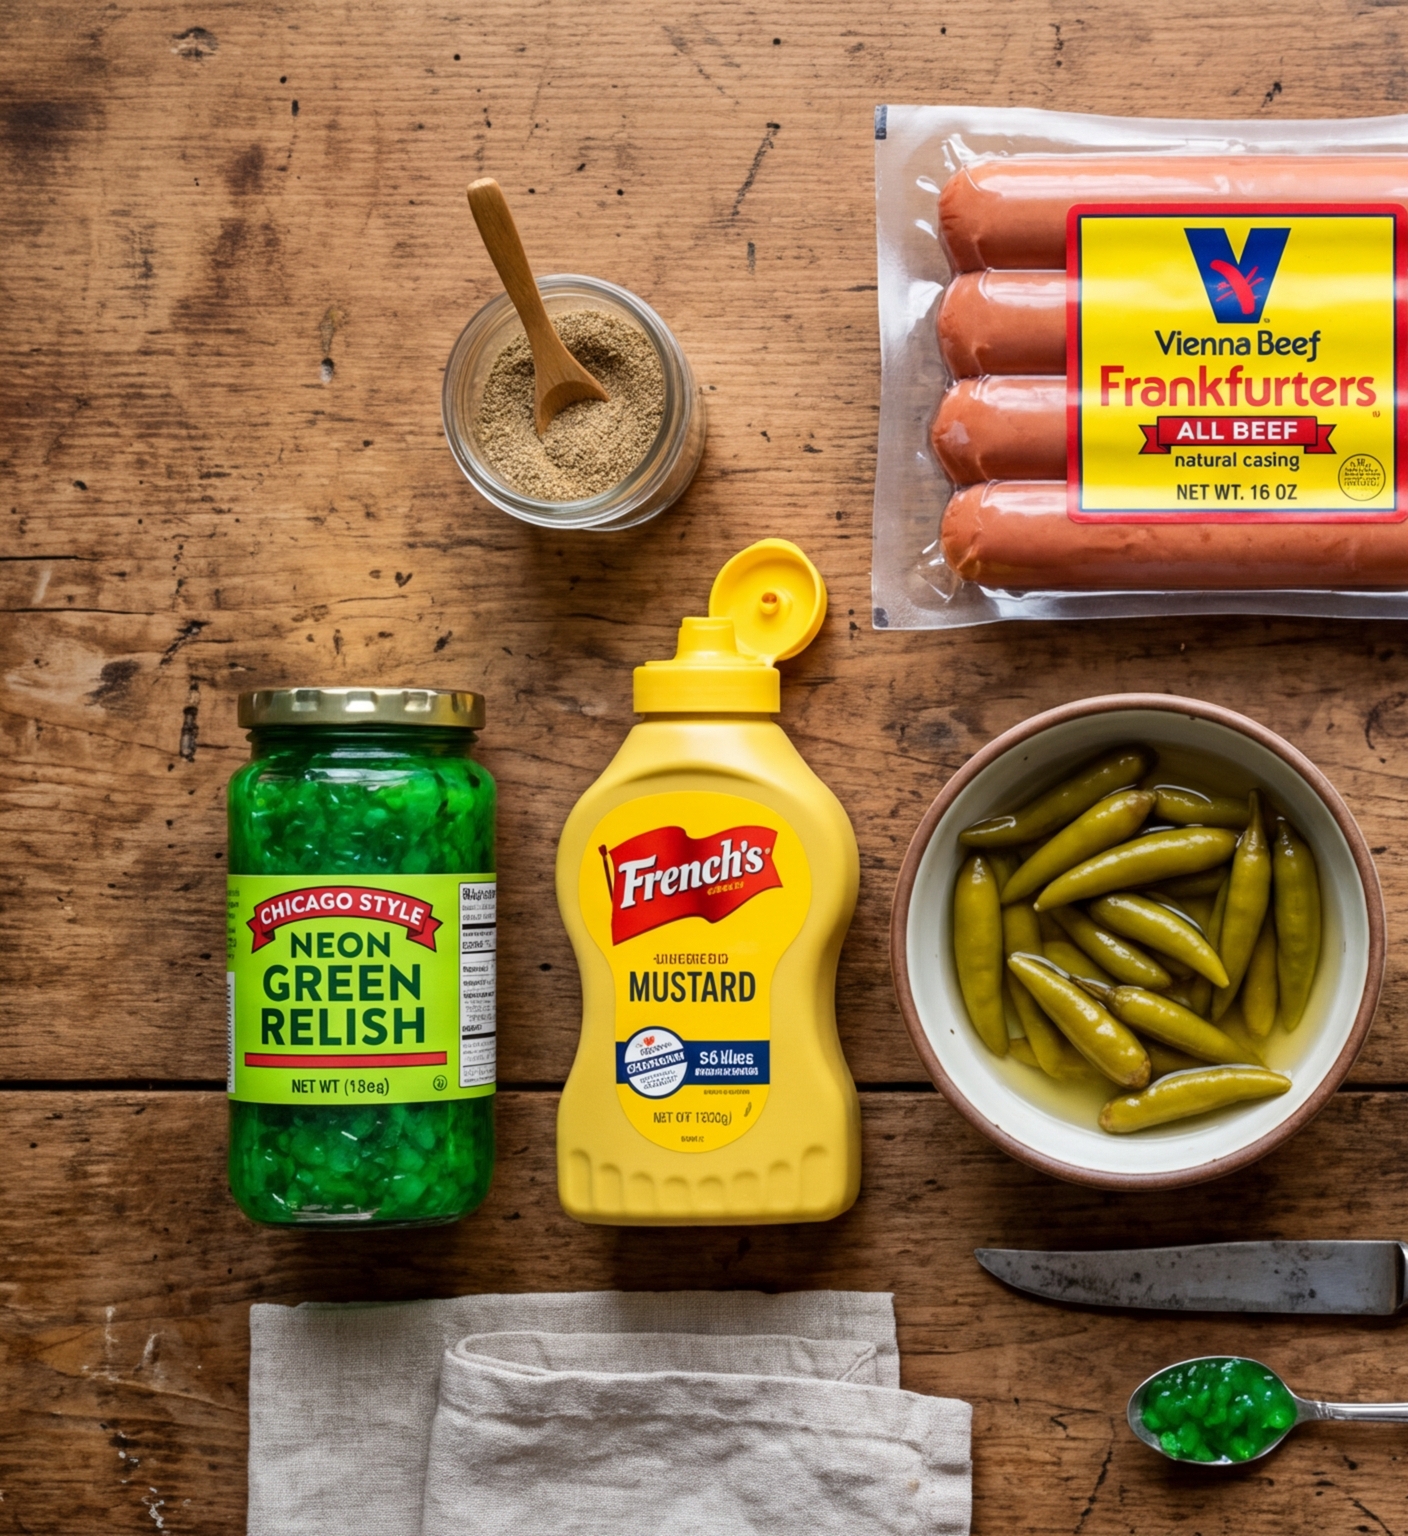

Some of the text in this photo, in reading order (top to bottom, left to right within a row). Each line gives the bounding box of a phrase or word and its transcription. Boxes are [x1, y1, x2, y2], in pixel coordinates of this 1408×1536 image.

[1153, 329, 1322, 363] Vienna Beef
[1099, 364, 1378, 408] Frankfurters
[1176, 420, 1299, 440] ALL BEEF
[1174, 451, 1301, 472] natural casing
[1176, 483, 1298, 501] NET WT. 16 OZ
[617, 838, 764, 910] French's
[259, 892, 354, 927] CHICAGO
[358, 892, 426, 927] STYLE
[290, 931, 392, 959] NEON
[262, 963, 422, 1003] GREEN
[628, 970, 757, 1003] MUSTARD
[260, 1006, 426, 1047] RELISH
[290, 1079, 316, 1095] NET
[319, 1079, 340, 1095] WT
